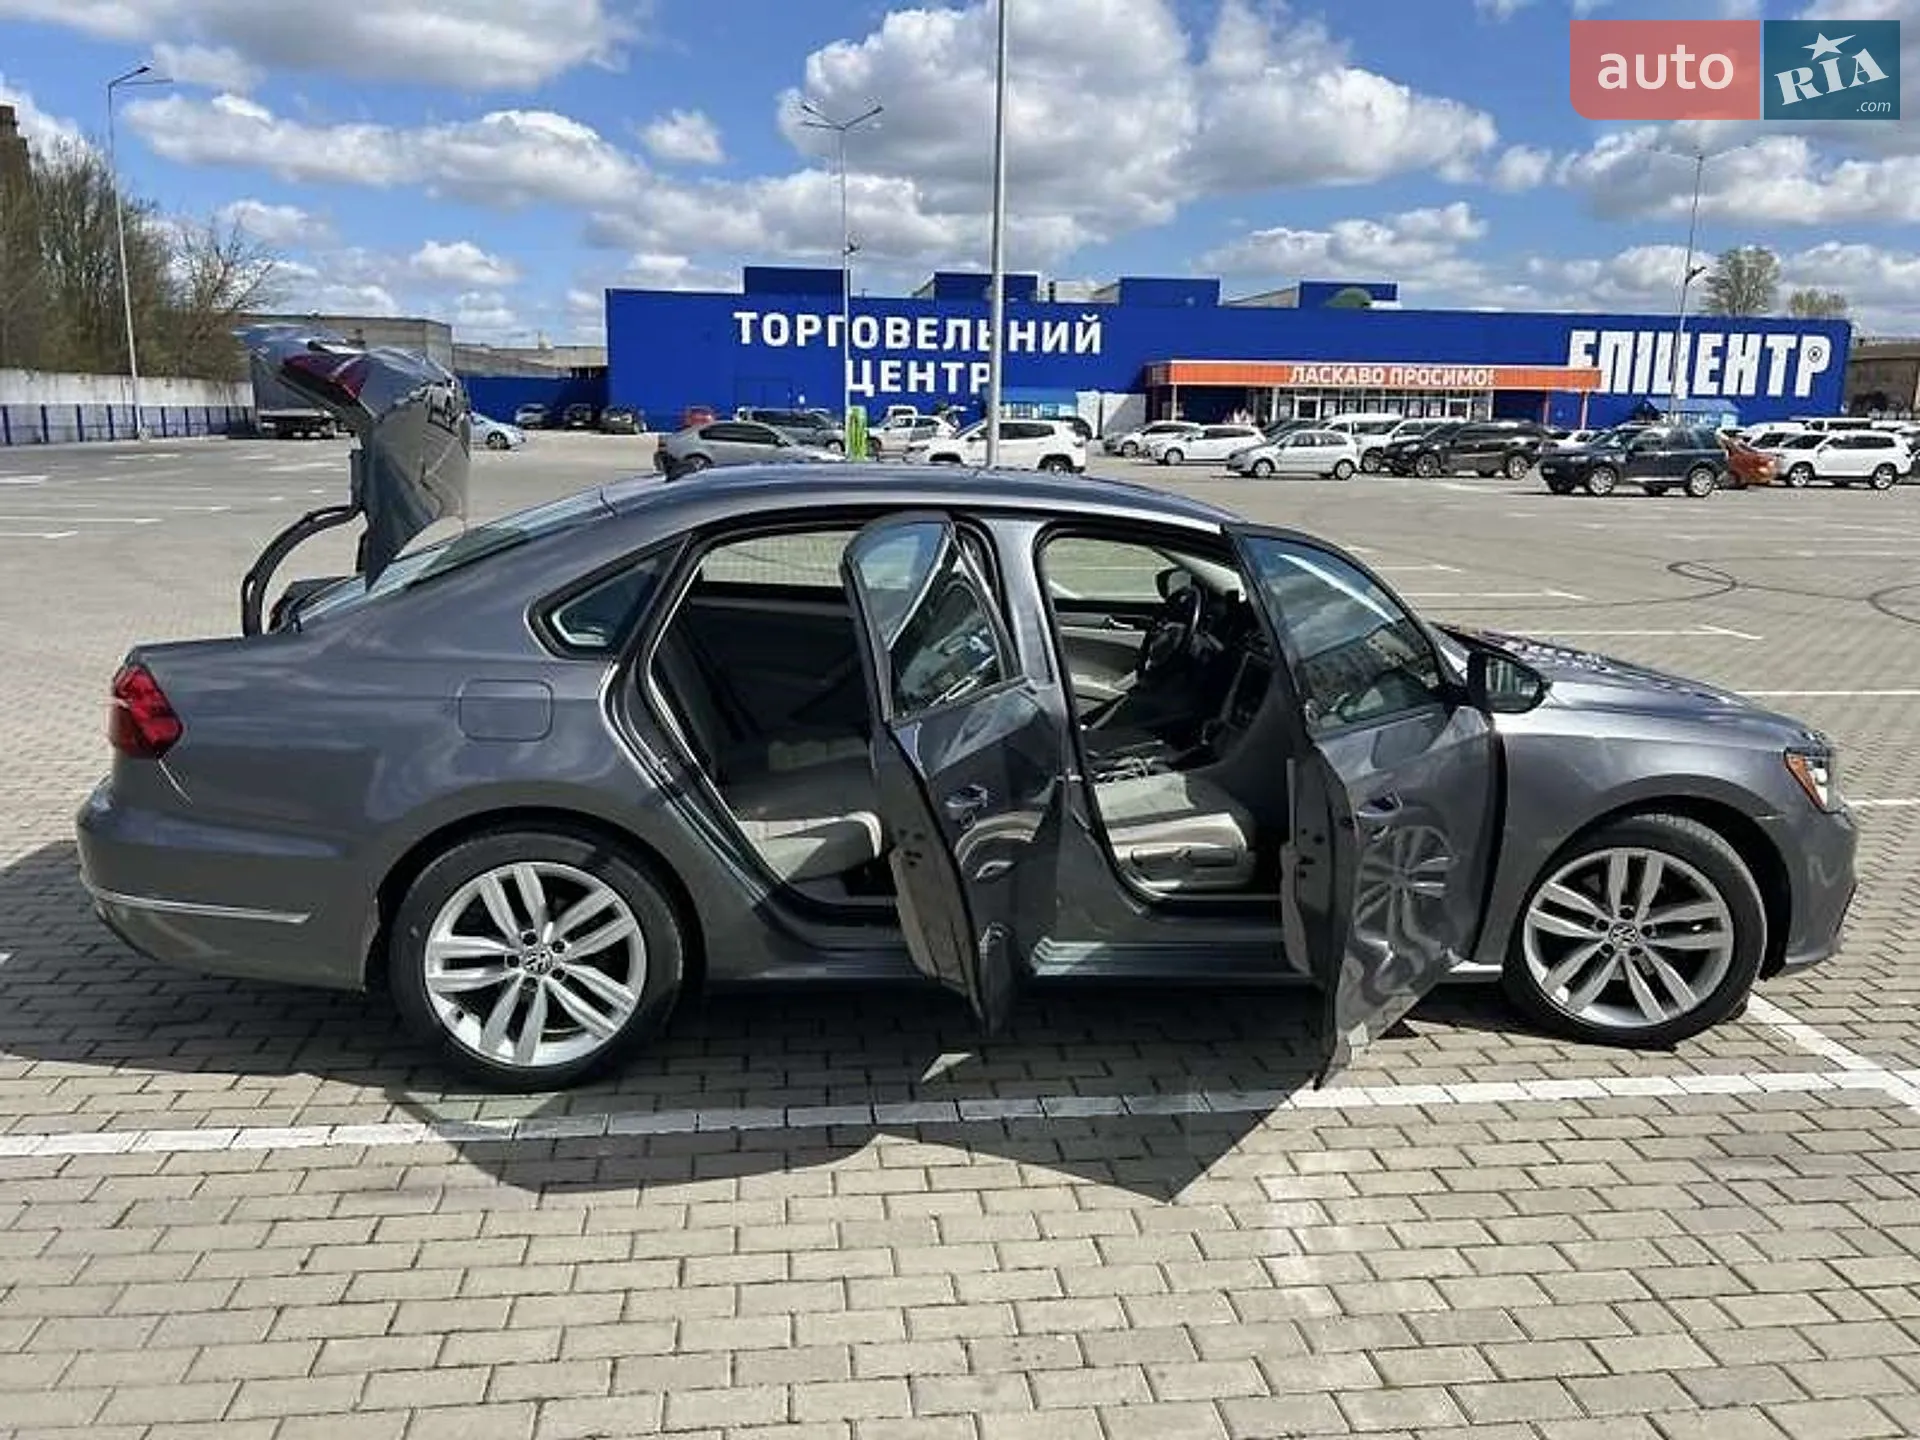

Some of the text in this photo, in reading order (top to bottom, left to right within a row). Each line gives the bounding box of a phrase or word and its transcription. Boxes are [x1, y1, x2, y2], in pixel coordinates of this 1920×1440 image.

[733, 311, 1101, 355] ТОРГОВЕЛЬНИЙ
[846, 359, 991, 398] ЦЕНТР
[1289, 365, 1495, 387] ЛАСКАВО ПРОСИМО!
